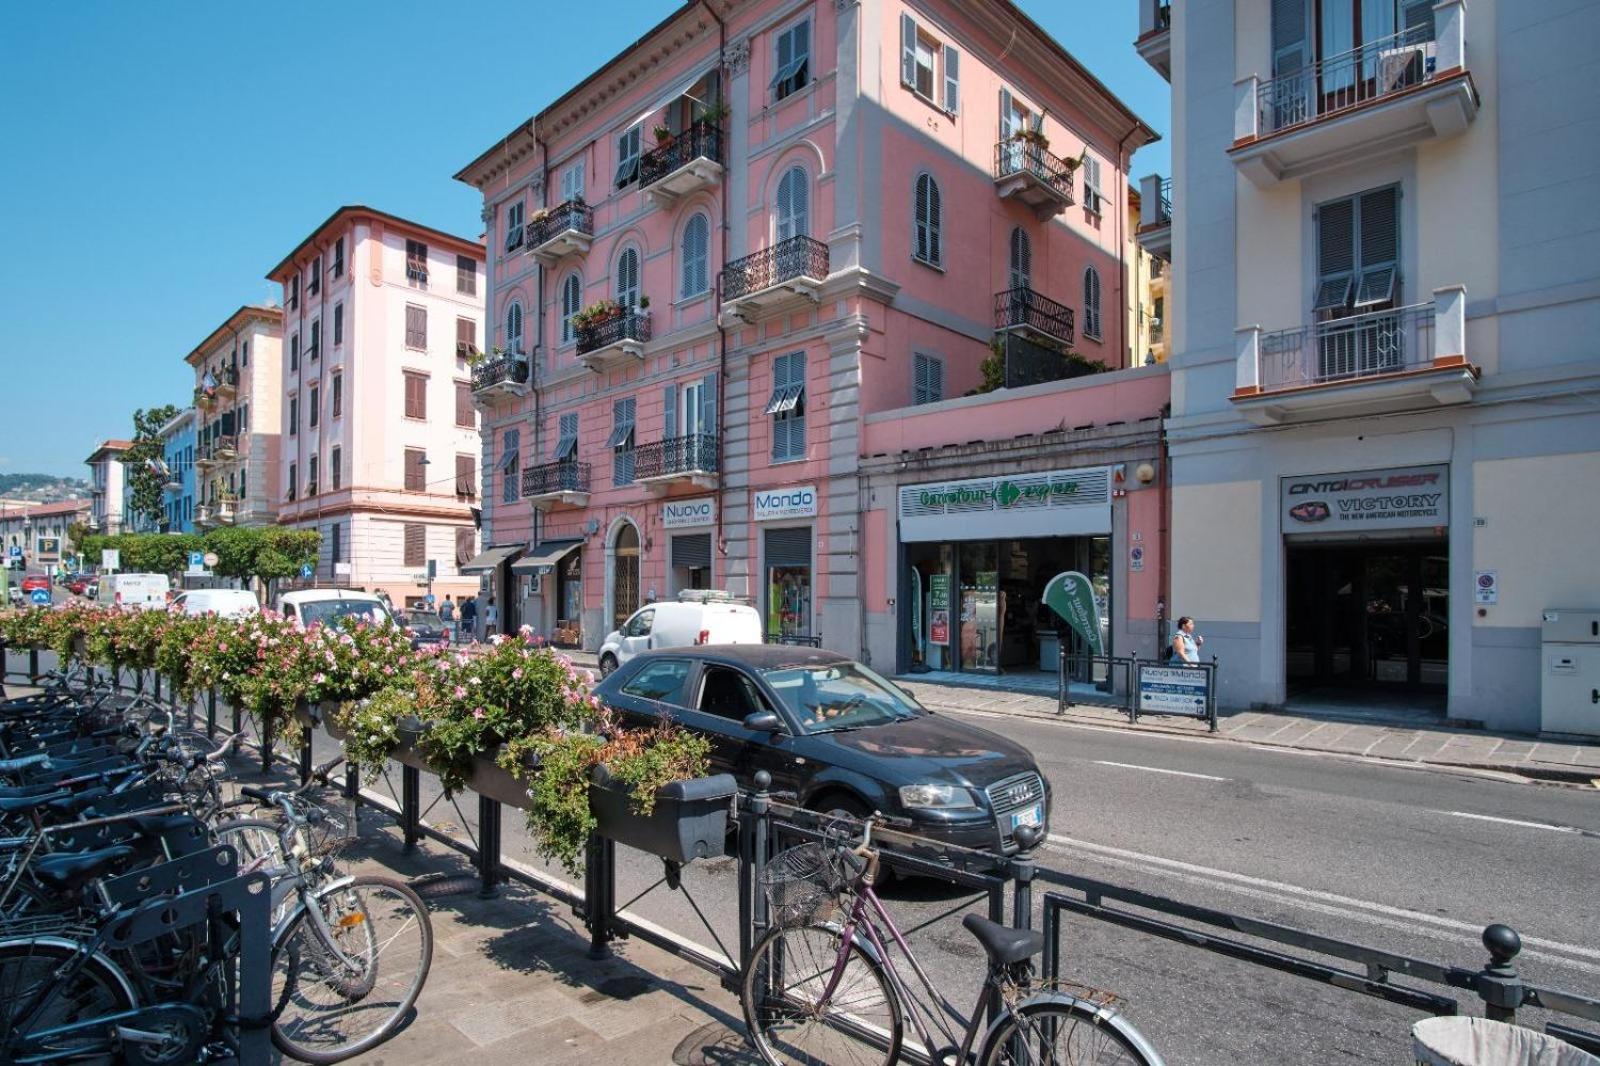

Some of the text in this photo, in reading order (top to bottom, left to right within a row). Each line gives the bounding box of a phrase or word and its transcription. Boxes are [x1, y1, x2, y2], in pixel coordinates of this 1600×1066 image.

[756, 491, 813, 510] Mondo
[1338, 493, 1442, 511] VICTORY
[1351, 512, 1364, 520] NEW
[12, 547, 20, 556] P
[44, 541, 53, 551] P
[191, 552, 202, 564] P
